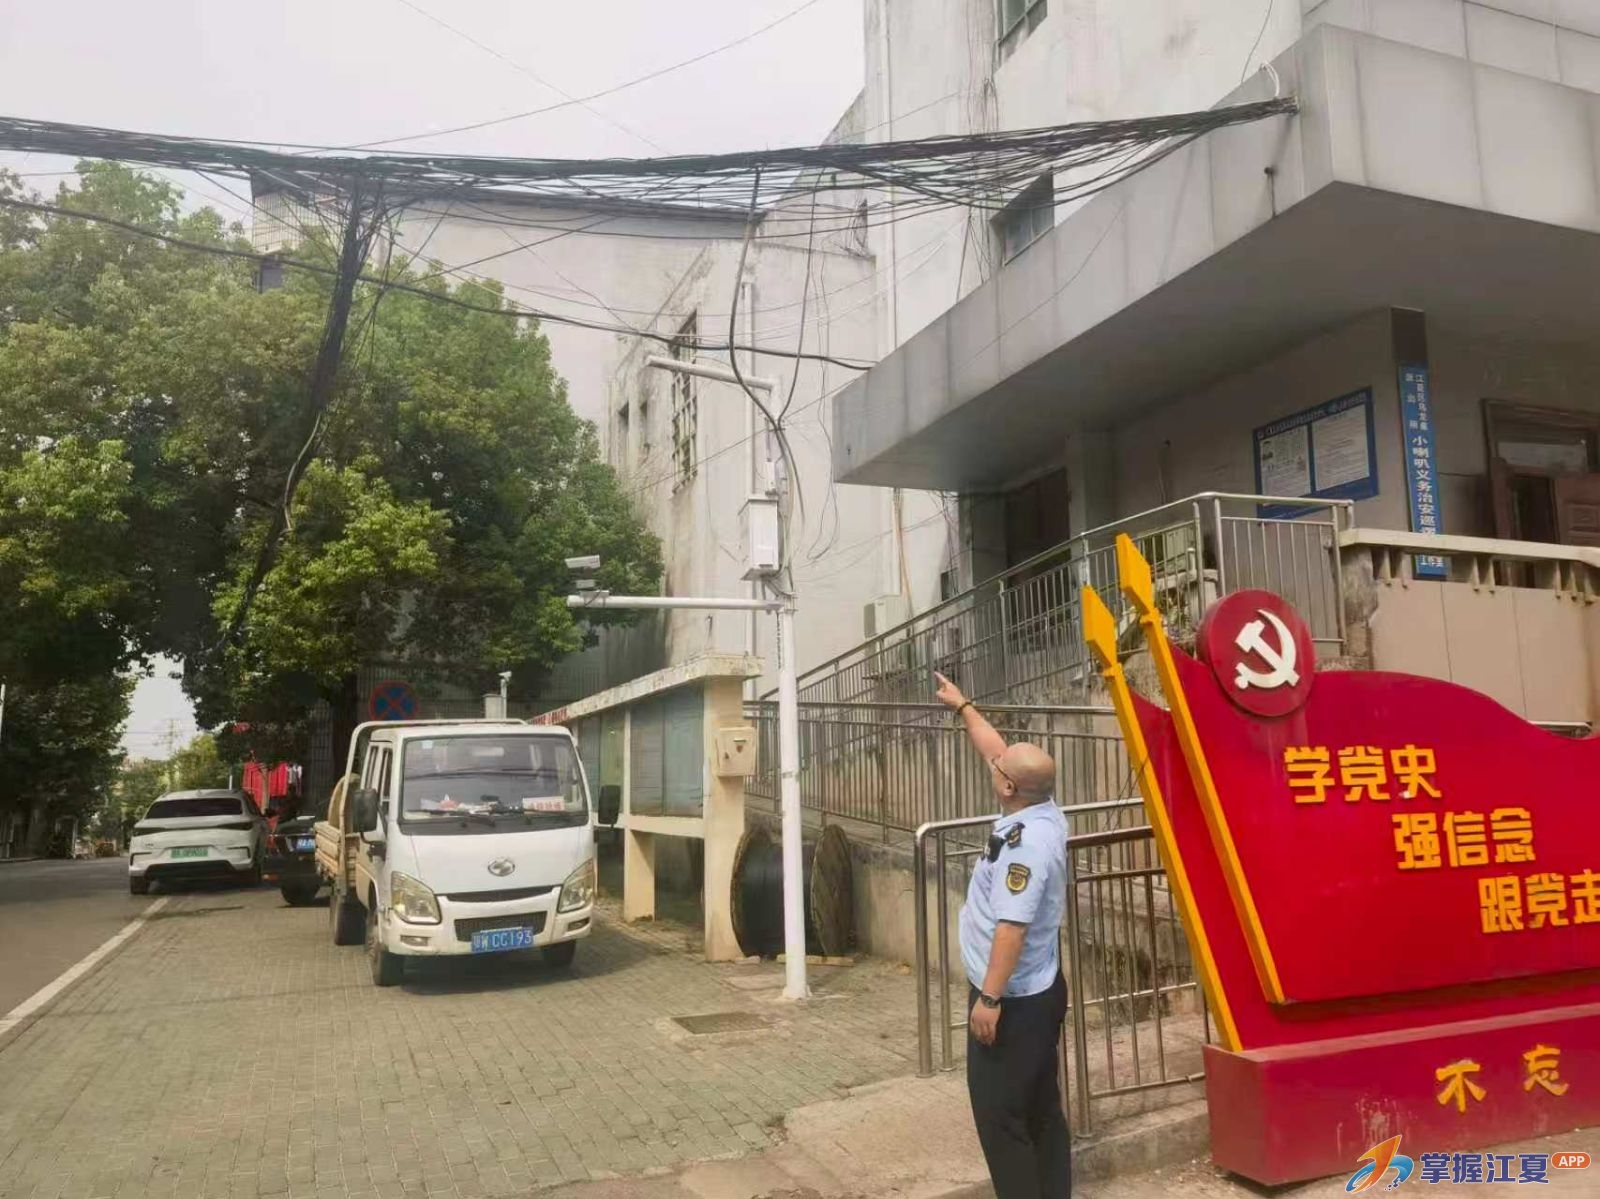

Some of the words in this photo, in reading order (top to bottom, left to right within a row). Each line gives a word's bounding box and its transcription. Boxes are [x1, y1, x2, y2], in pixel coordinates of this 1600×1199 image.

[1284, 744, 1442, 804] 学党史
[1391, 807, 1536, 869] 强信念
[1478, 868, 1600, 934] 跟党走
